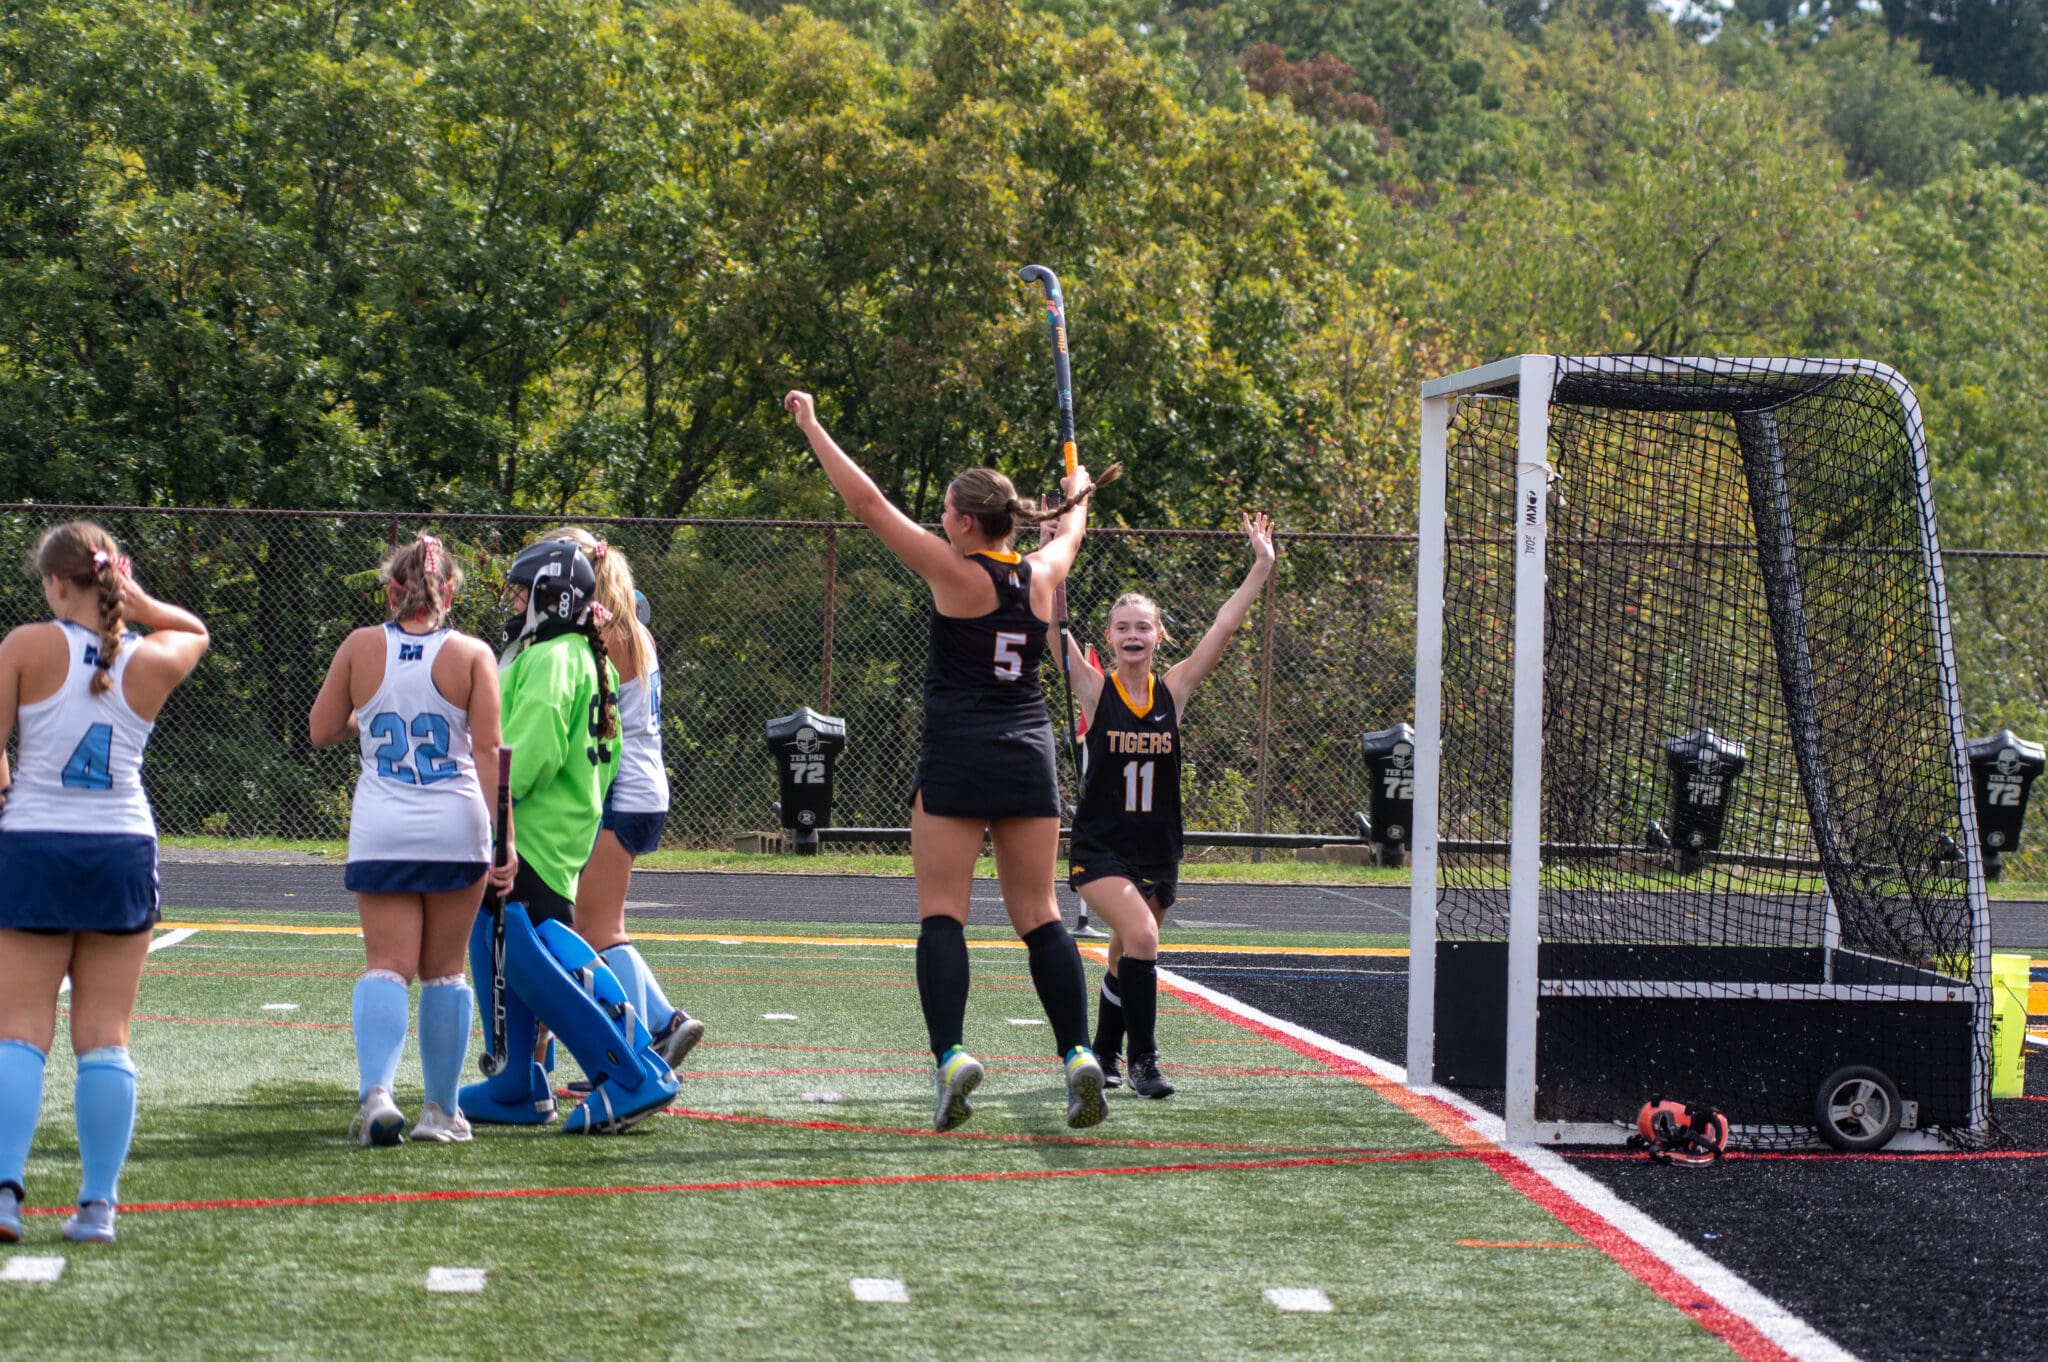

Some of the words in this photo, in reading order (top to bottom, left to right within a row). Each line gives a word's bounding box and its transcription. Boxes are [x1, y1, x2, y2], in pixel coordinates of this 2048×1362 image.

[994, 631, 1027, 681] 5
[61, 721, 113, 790] 4
[369, 712, 462, 785] 22
[1107, 730, 1172, 754] TIGERS
[789, 762, 825, 784] 72
[1123, 761, 1155, 812] 11
[1383, 777, 1414, 800] 72
[1987, 782, 2021, 806] 72
